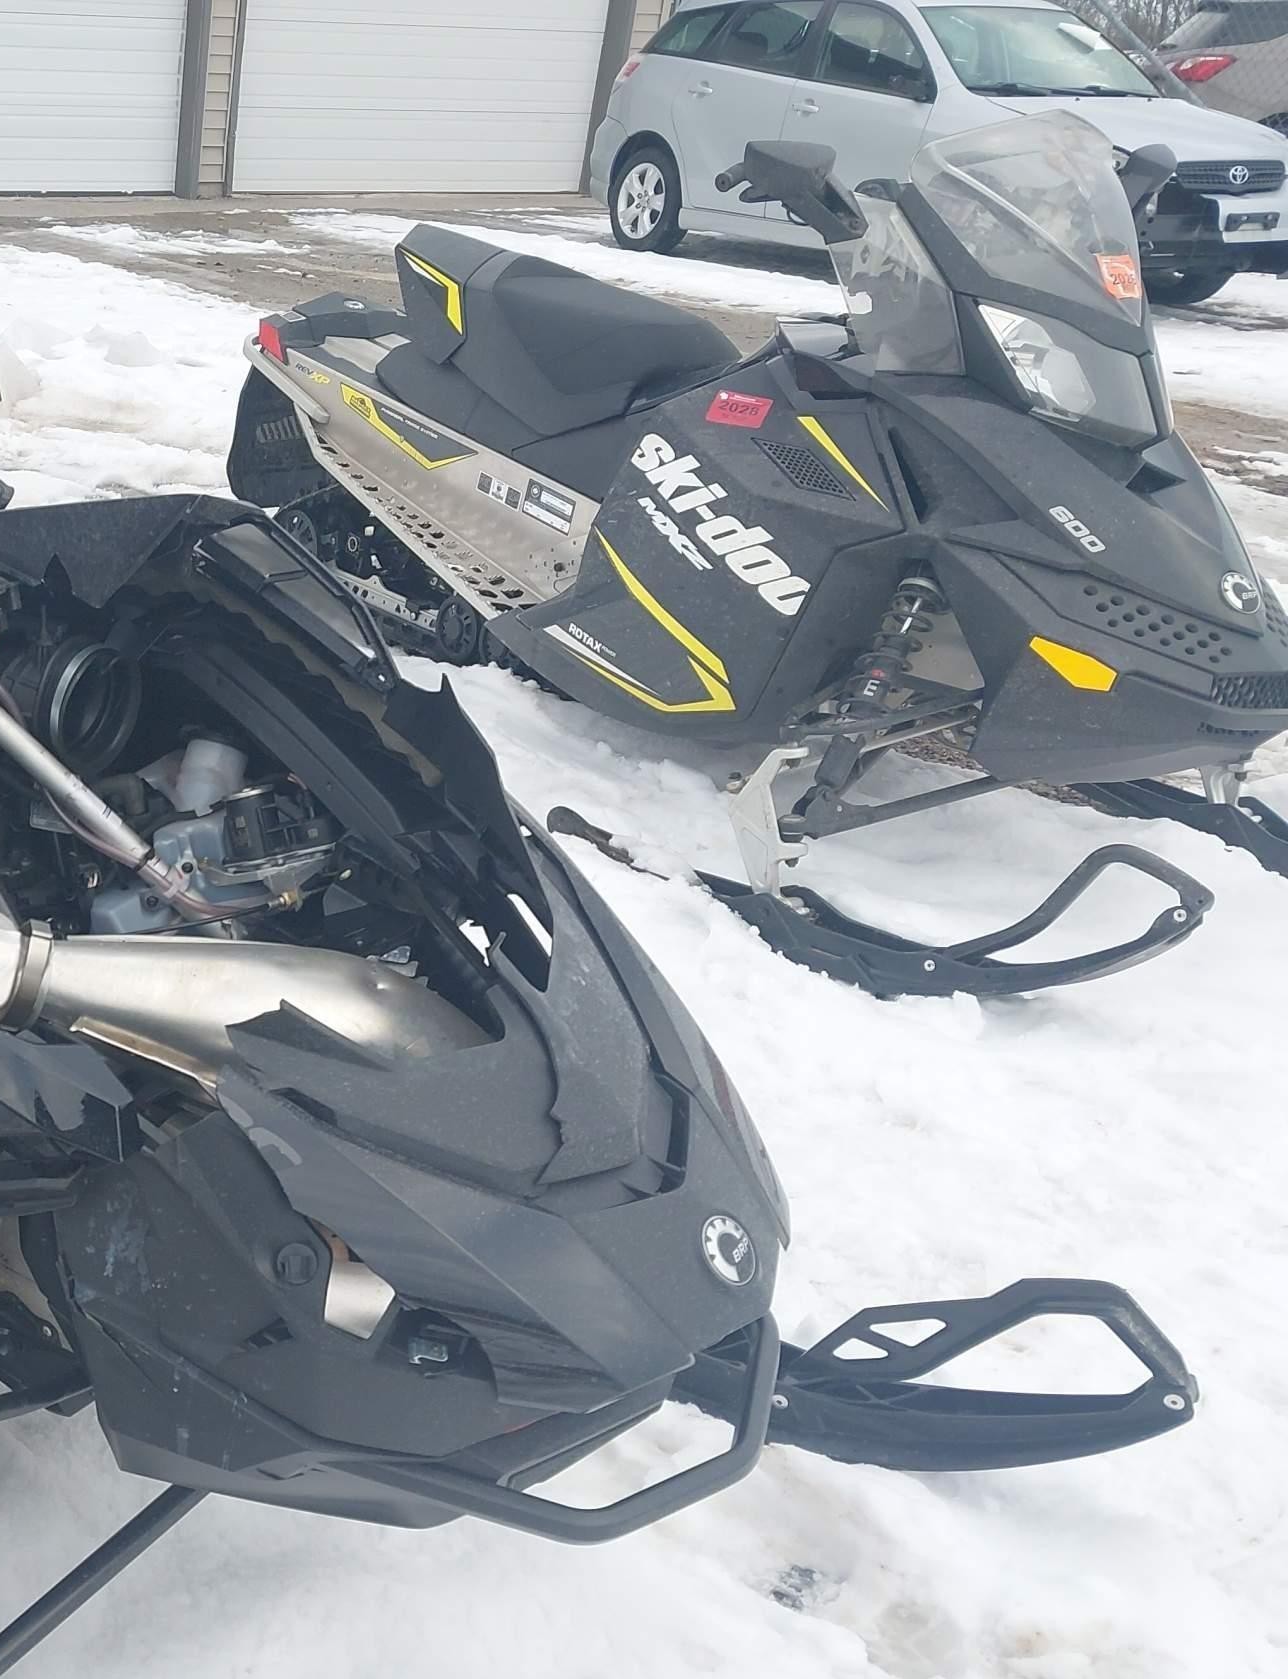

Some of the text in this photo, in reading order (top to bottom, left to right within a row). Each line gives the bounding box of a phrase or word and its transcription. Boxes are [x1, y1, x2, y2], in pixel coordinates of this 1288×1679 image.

[718, 401, 760, 416] 2028
[1048, 505, 1106, 553] 600
[568, 622, 602, 653] ROTAX
[732, 1237, 749, 1263] BRP
